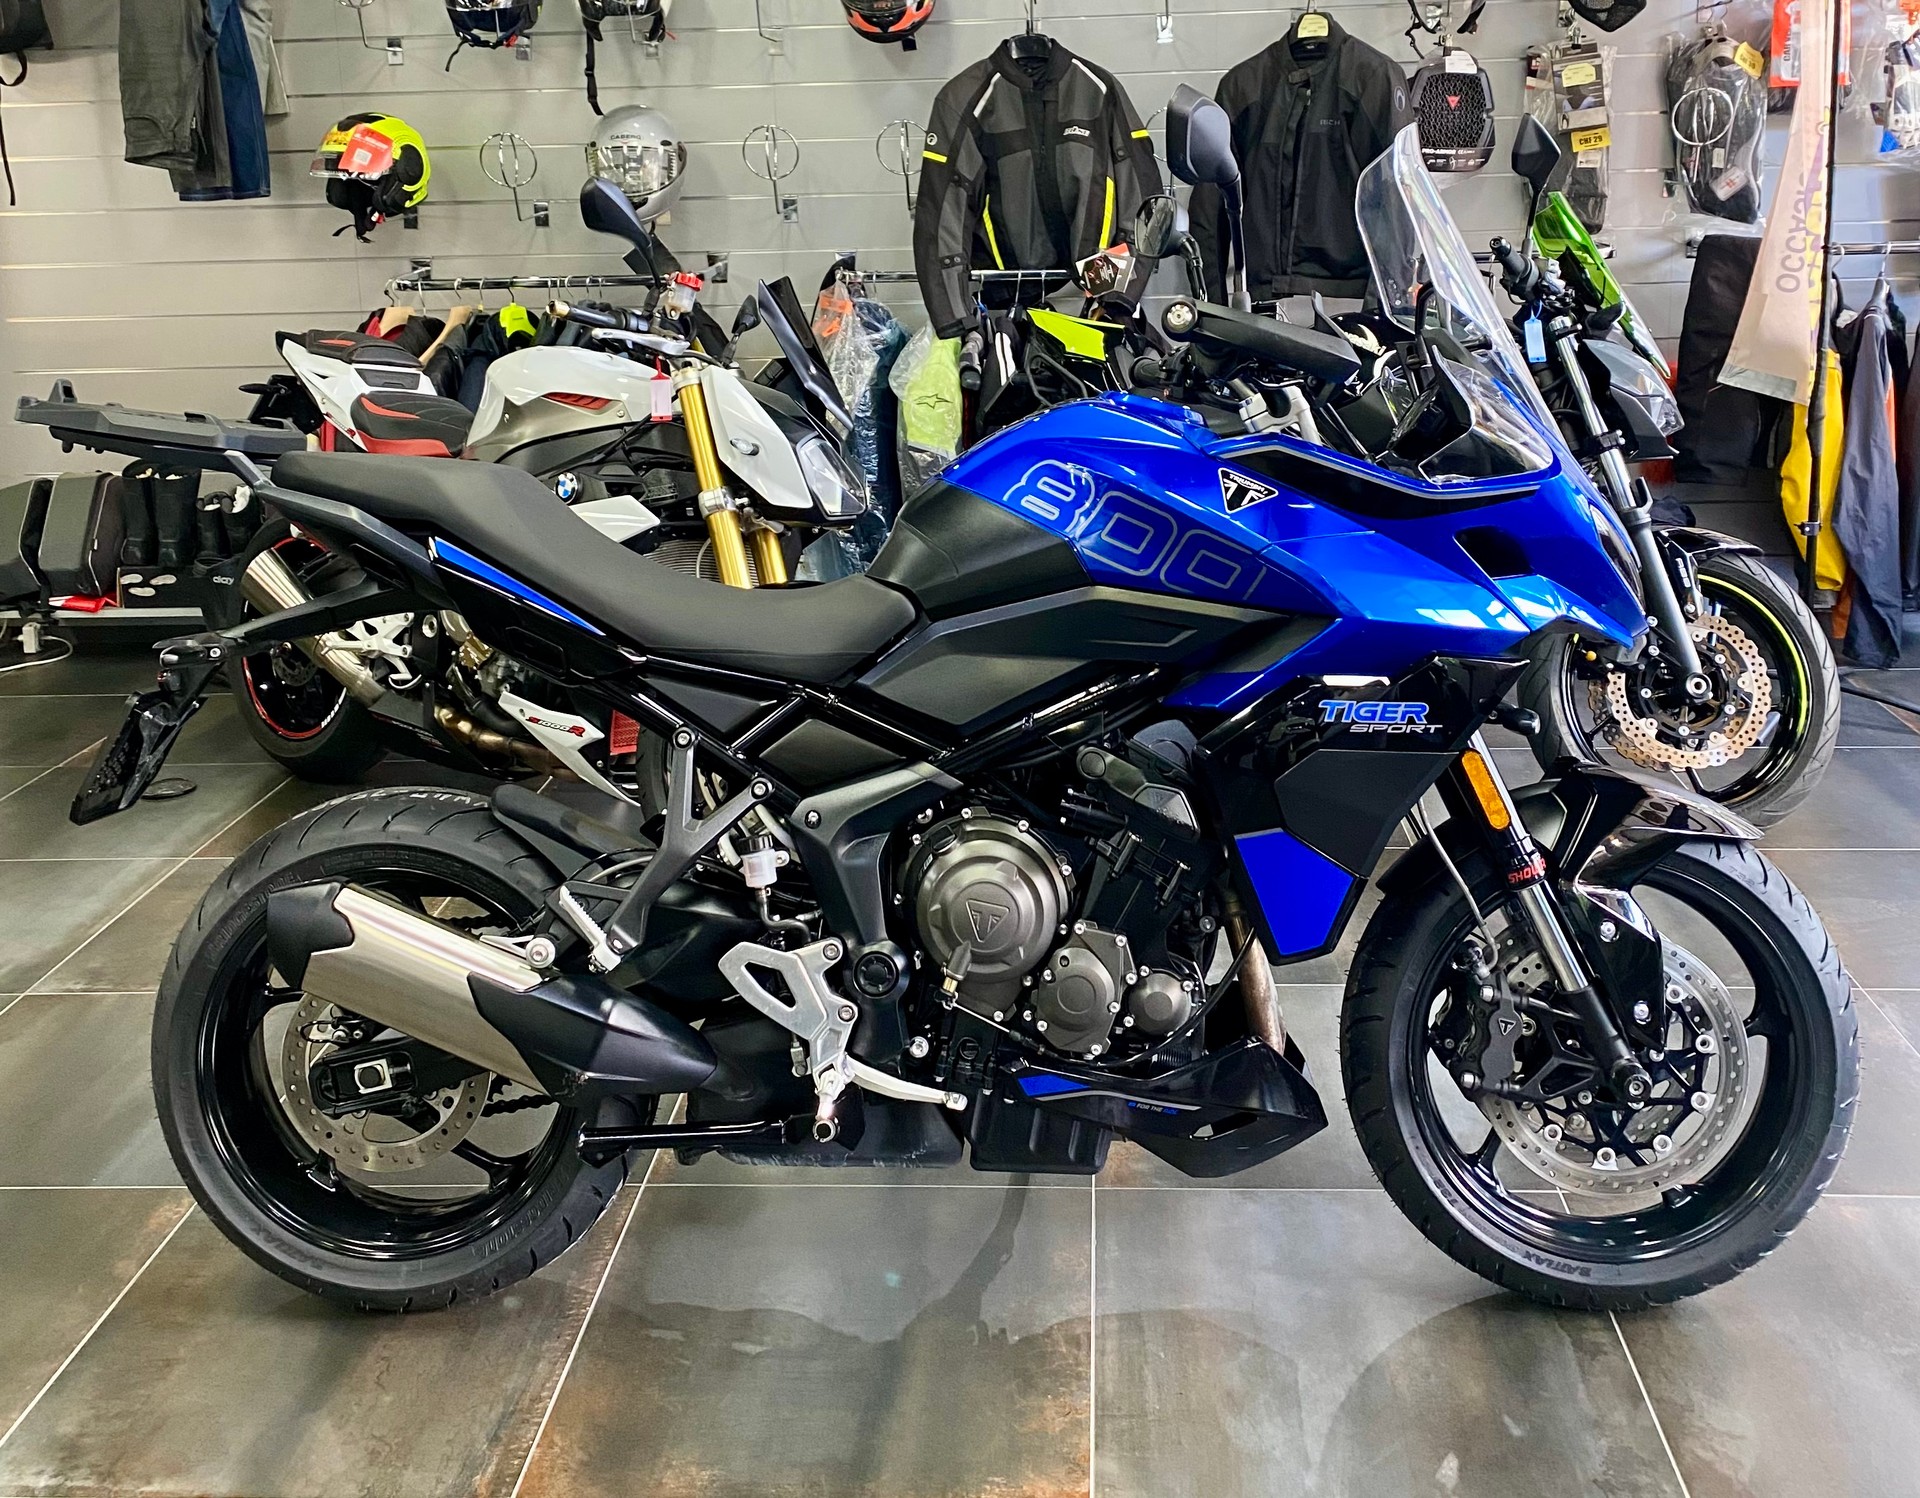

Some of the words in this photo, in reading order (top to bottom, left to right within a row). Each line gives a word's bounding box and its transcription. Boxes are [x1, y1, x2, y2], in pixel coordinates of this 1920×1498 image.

[1579, 137, 1594, 146] CHF
[1594, 135, 1603, 143] 29
[1229, 473, 1268, 494] TRIUMPH
[1002, 459, 1267, 601] 800
[1318, 699, 1430, 724] TIGER
[525, 716, 586, 738] S1000R
[1349, 724, 1444, 734] SPORT
[1136, 1102, 1150, 1110] FOR
[1150, 1105, 1163, 1113] THE
